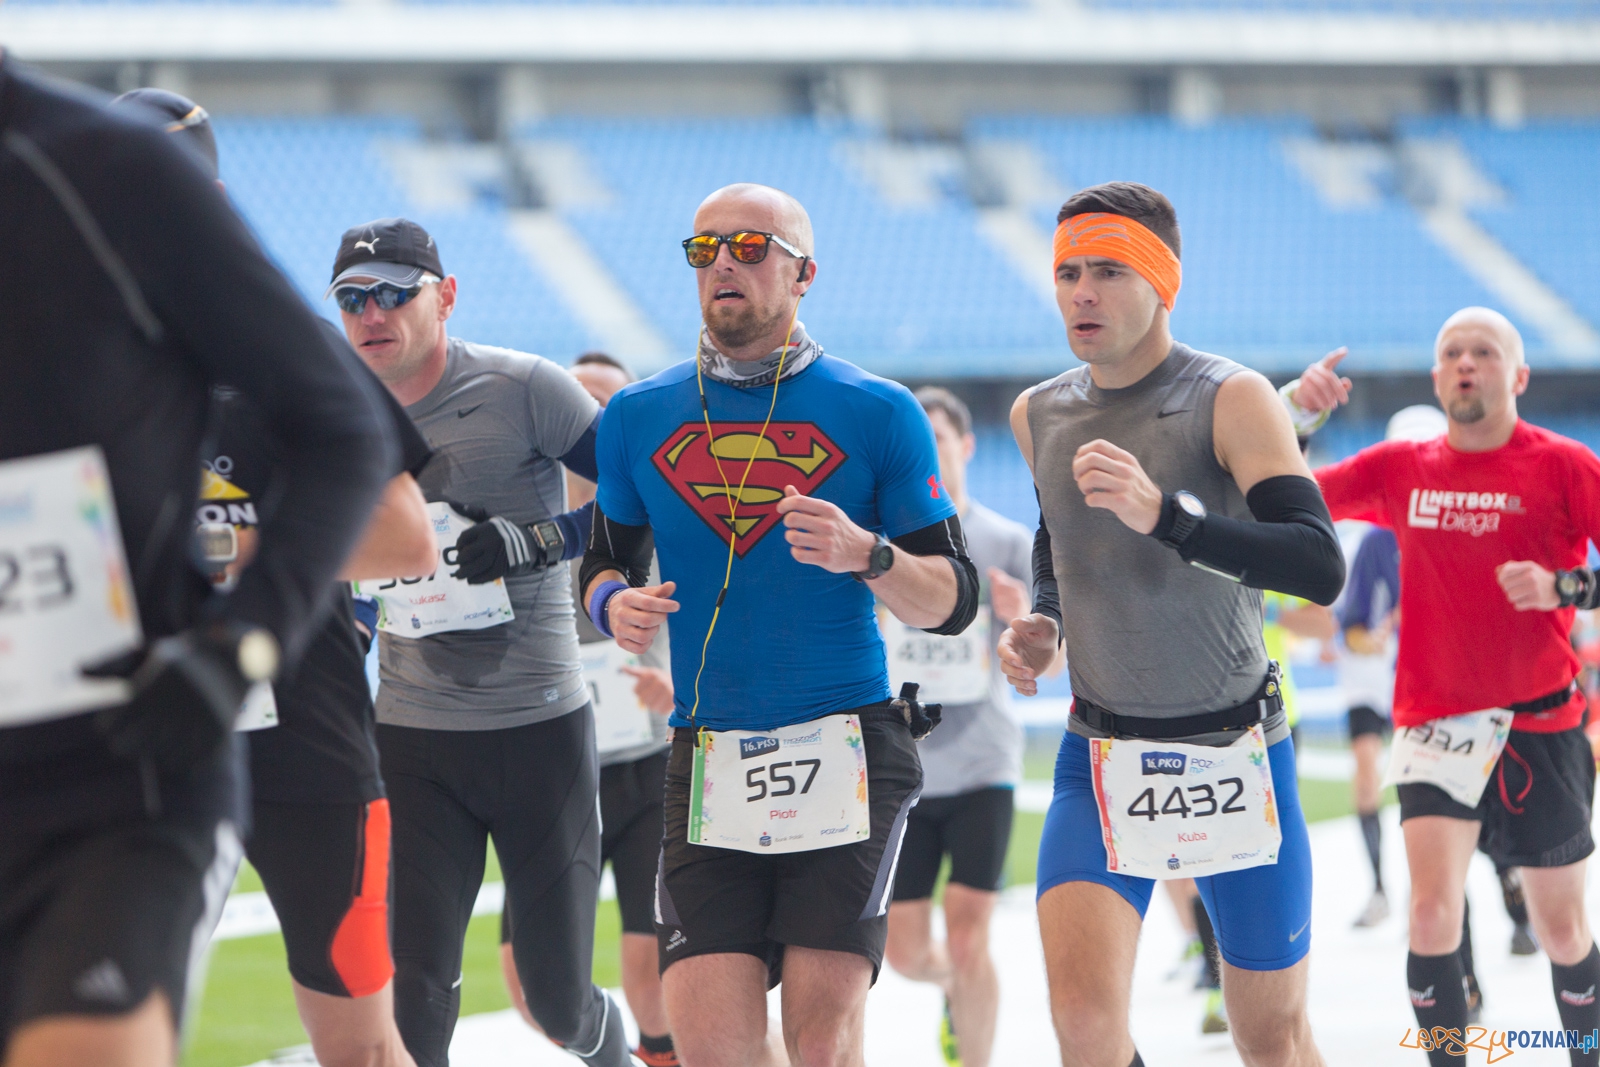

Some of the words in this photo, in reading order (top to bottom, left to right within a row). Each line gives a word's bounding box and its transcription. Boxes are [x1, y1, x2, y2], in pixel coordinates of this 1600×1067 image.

[1429, 489, 1508, 510] NETBOX
[1158, 758, 1183, 769] PKO
[746, 758, 821, 803] 557
[1126, 776, 1247, 822] 4432
[769, 808, 798, 820] Piotr
[1177, 831, 1208, 844] Kuba
